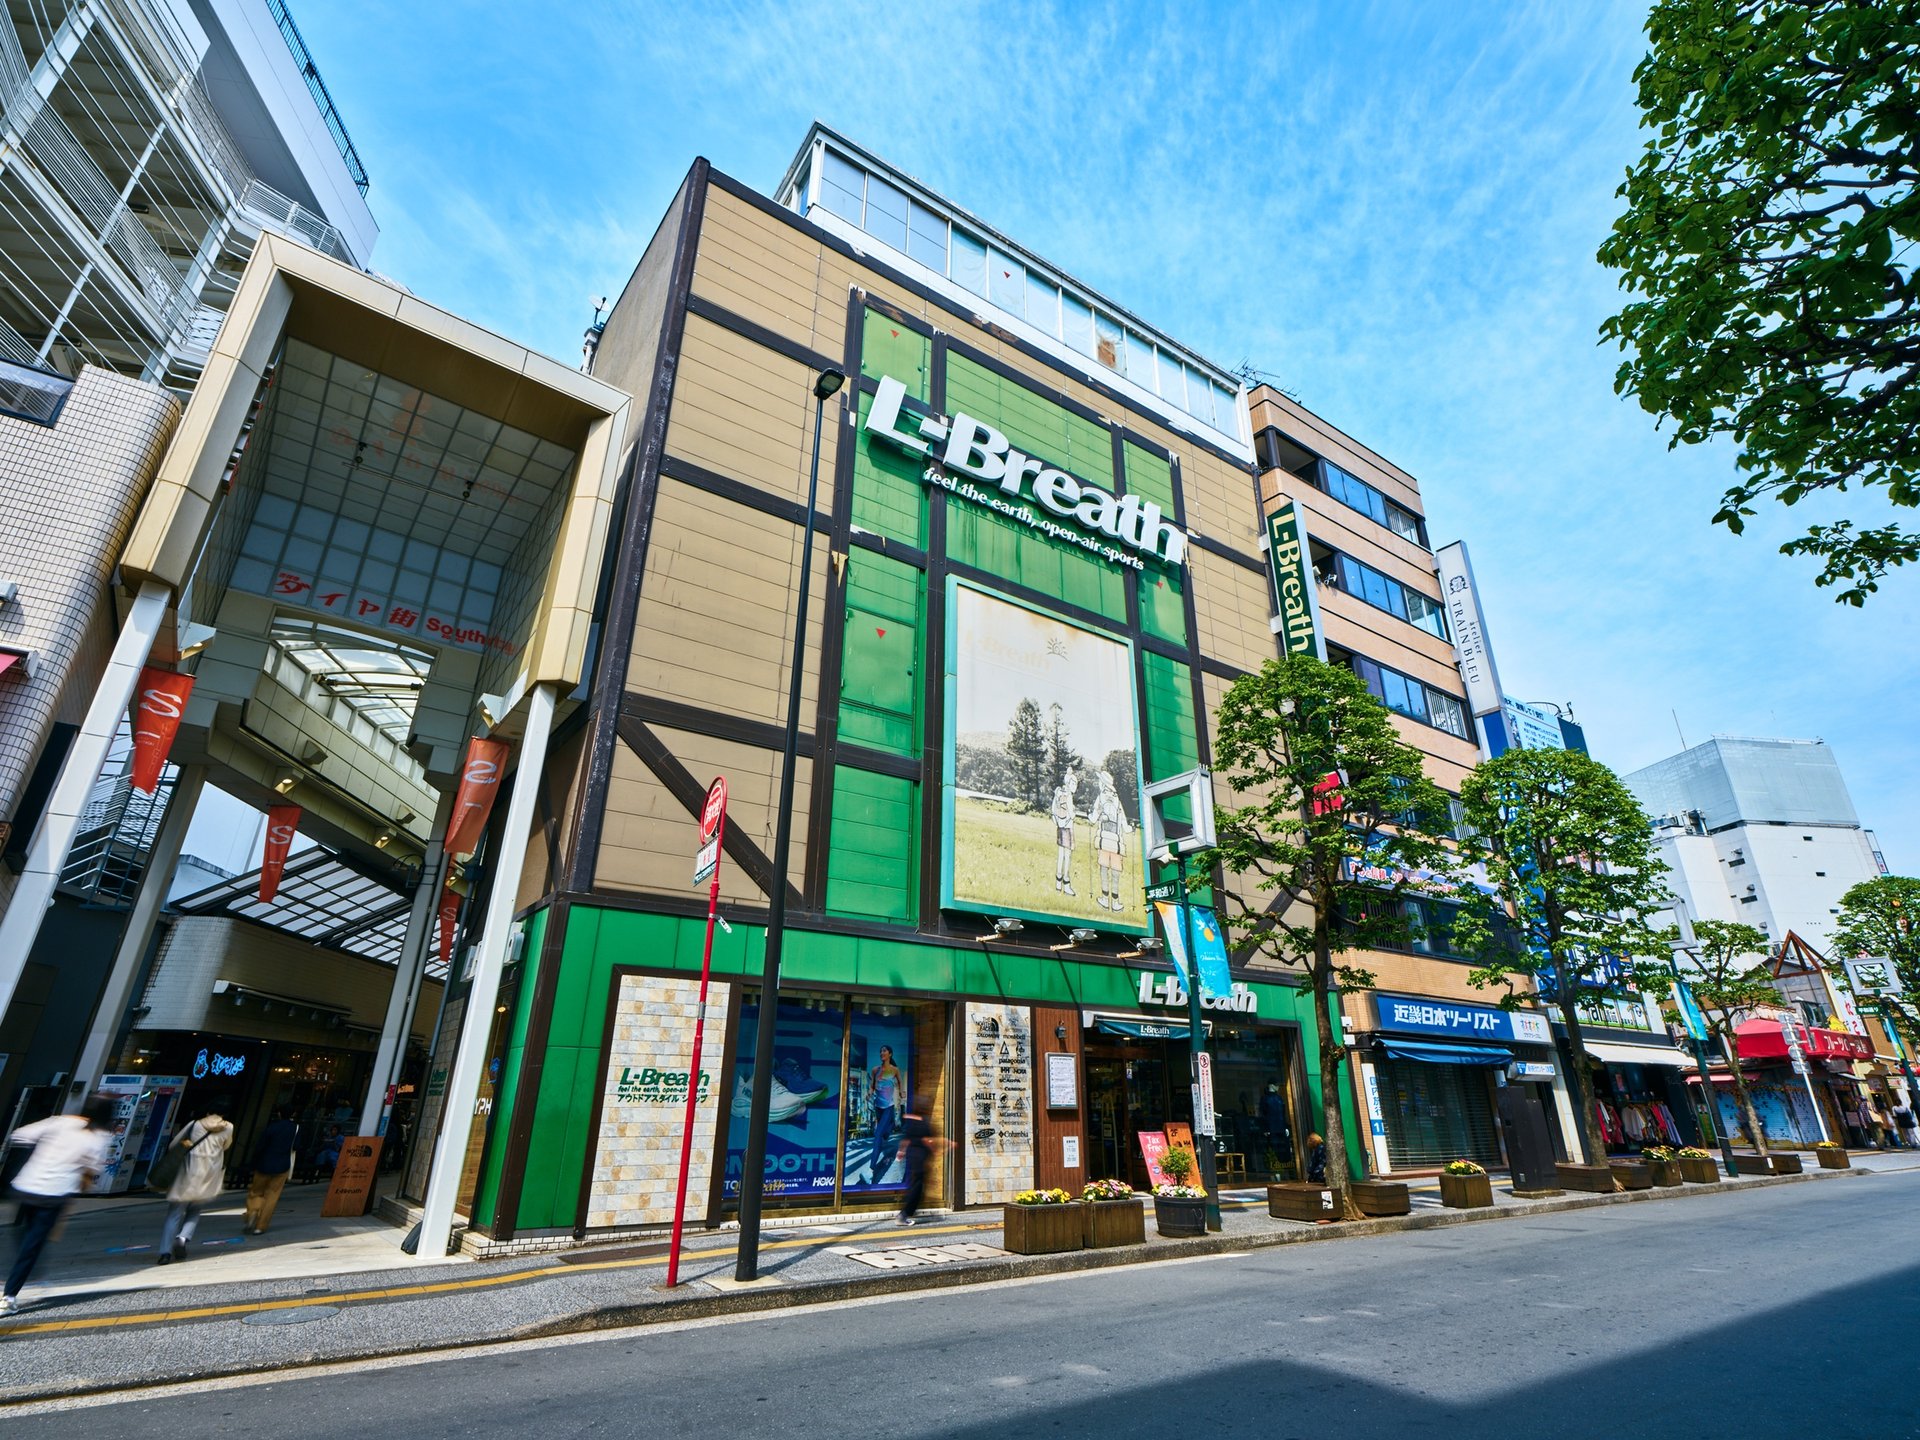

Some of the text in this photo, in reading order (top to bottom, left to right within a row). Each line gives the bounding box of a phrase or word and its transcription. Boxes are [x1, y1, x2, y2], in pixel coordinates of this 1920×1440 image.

[864, 375, 1188, 566] L-Breath
[924, 467, 1145, 571] feel the earth, open-air sports
[1272, 512, 1314, 652] L-Breath
[274, 577, 486, 646] ダイヤ街 South
[1452, 600, 1481, 684] TRAIN BLEU
[1146, 885, 1176, 899] 平和通り
[1393, 1004, 1501, 1031] 近畿日本ツーリスト
[1140, 1025, 1170, 1034] L-Breath
[619, 1067, 711, 1087] L-Breah
[631, 1085, 641, 1093] the
[643, 1086, 660, 1094] earth,
[1145, 1135, 1161, 1144] Tax
[1146, 1143, 1163, 1152] Free
